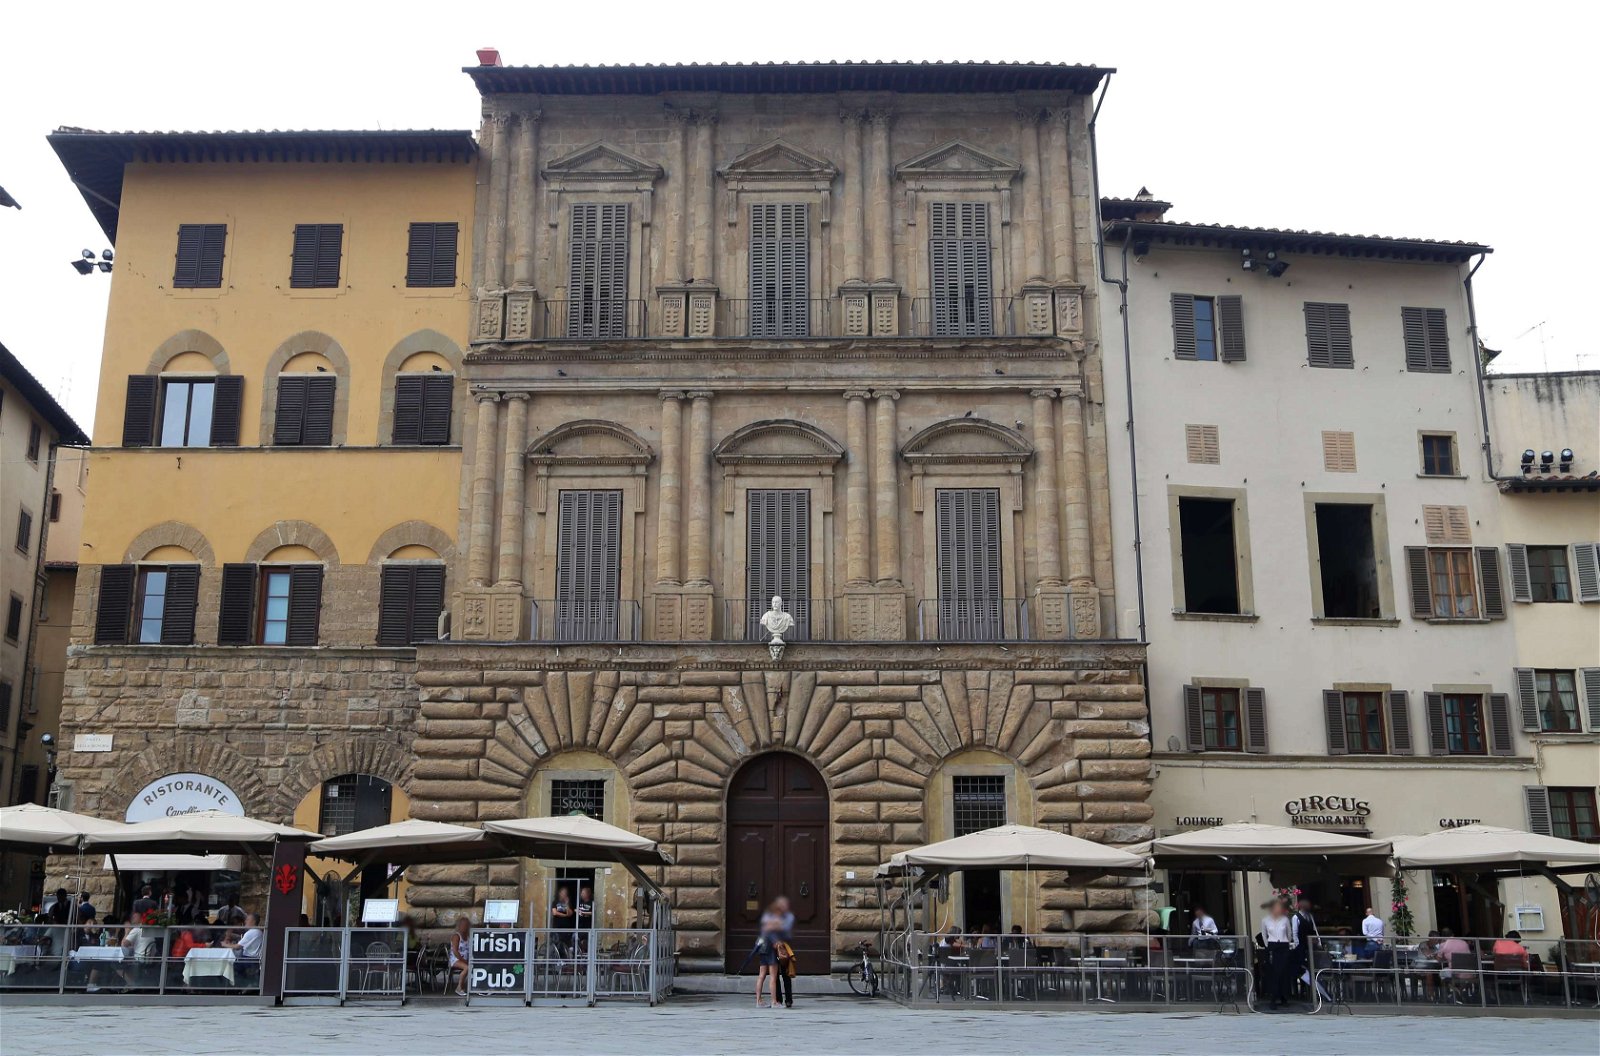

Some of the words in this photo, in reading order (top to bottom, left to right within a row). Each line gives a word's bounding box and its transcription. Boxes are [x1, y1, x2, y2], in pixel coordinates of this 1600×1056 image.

[143, 780, 230, 806] RISTORANTE
[569, 787, 589, 799] Old
[562, 797, 594, 810] Stove
[1285, 795, 1371, 816] CIRCUS
[1176, 816, 1224, 827] LOUNGE
[1291, 816, 1366, 825] RISTORANTE
[473, 933, 521, 952] Irish
[471, 967, 516, 988] Pub
